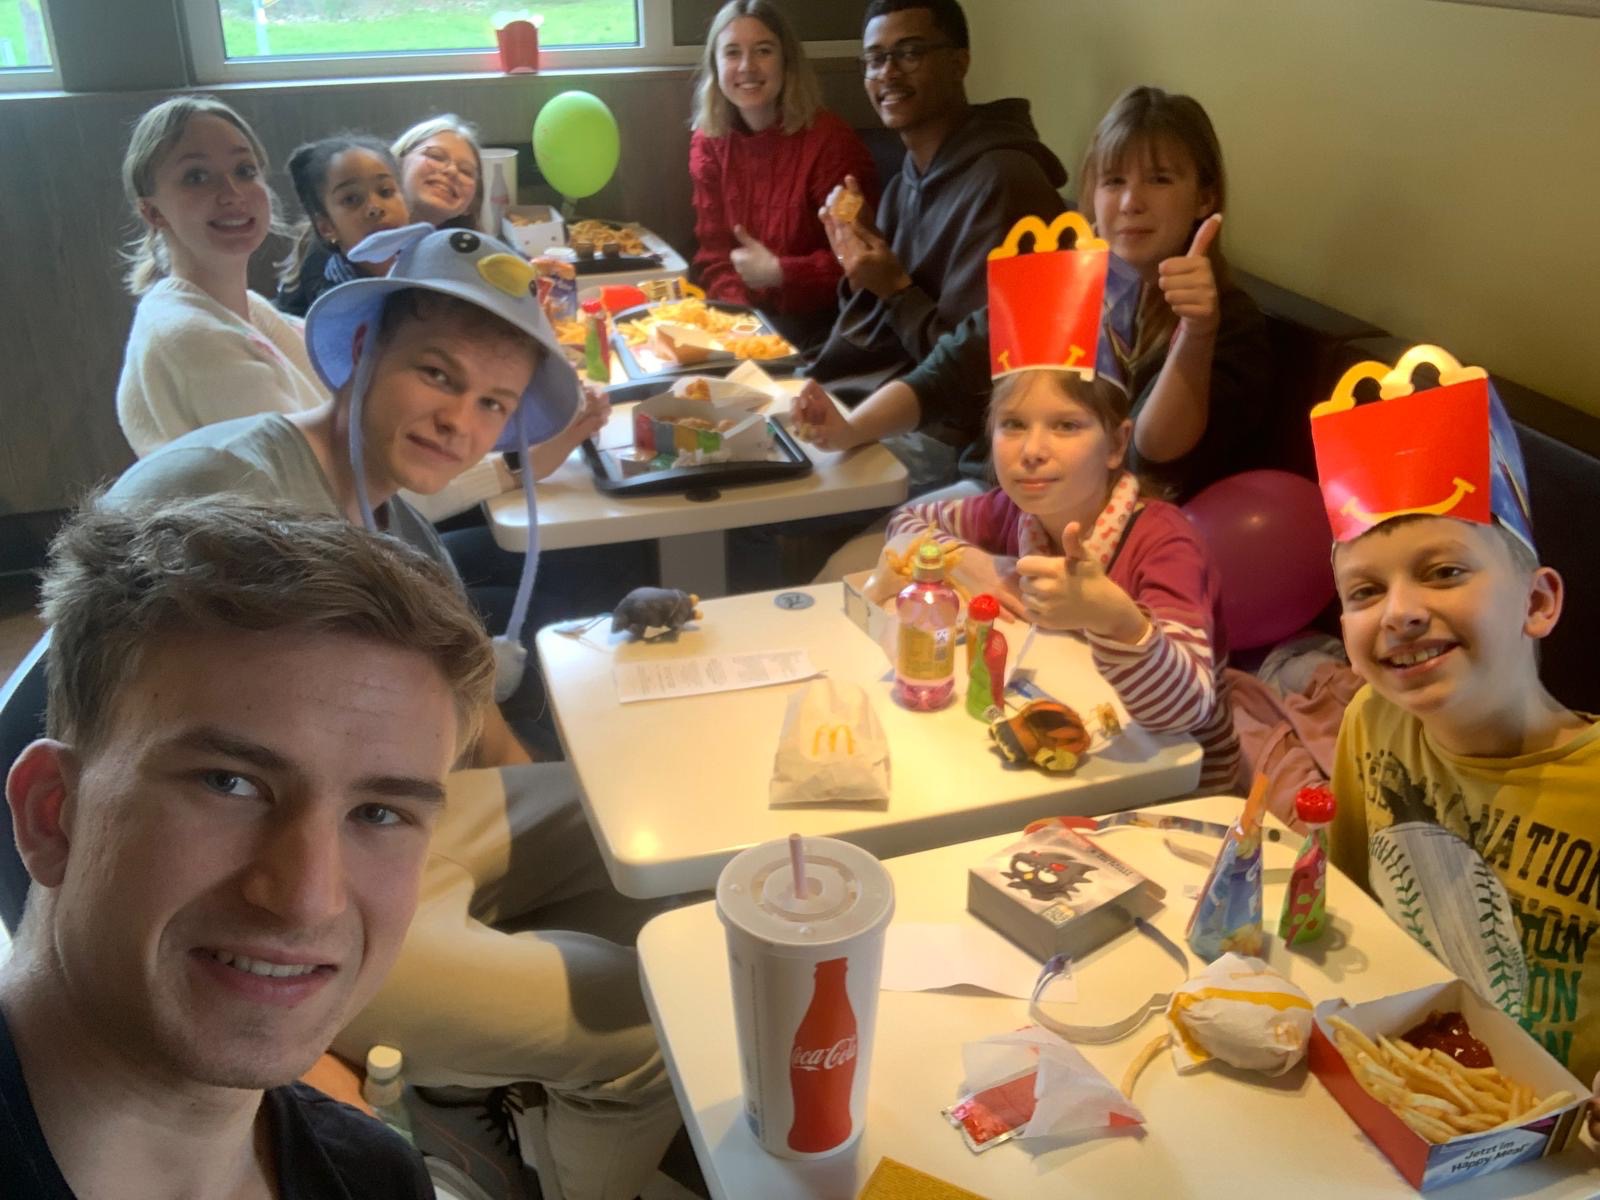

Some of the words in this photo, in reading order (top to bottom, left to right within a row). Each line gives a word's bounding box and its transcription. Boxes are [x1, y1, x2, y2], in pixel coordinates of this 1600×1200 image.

[1451, 1157, 1490, 1173] Happy
[1493, 1143, 1531, 1160] Meal
[1465, 1145, 1497, 1160] Jetzt
[1499, 1141, 1515, 1149] im
